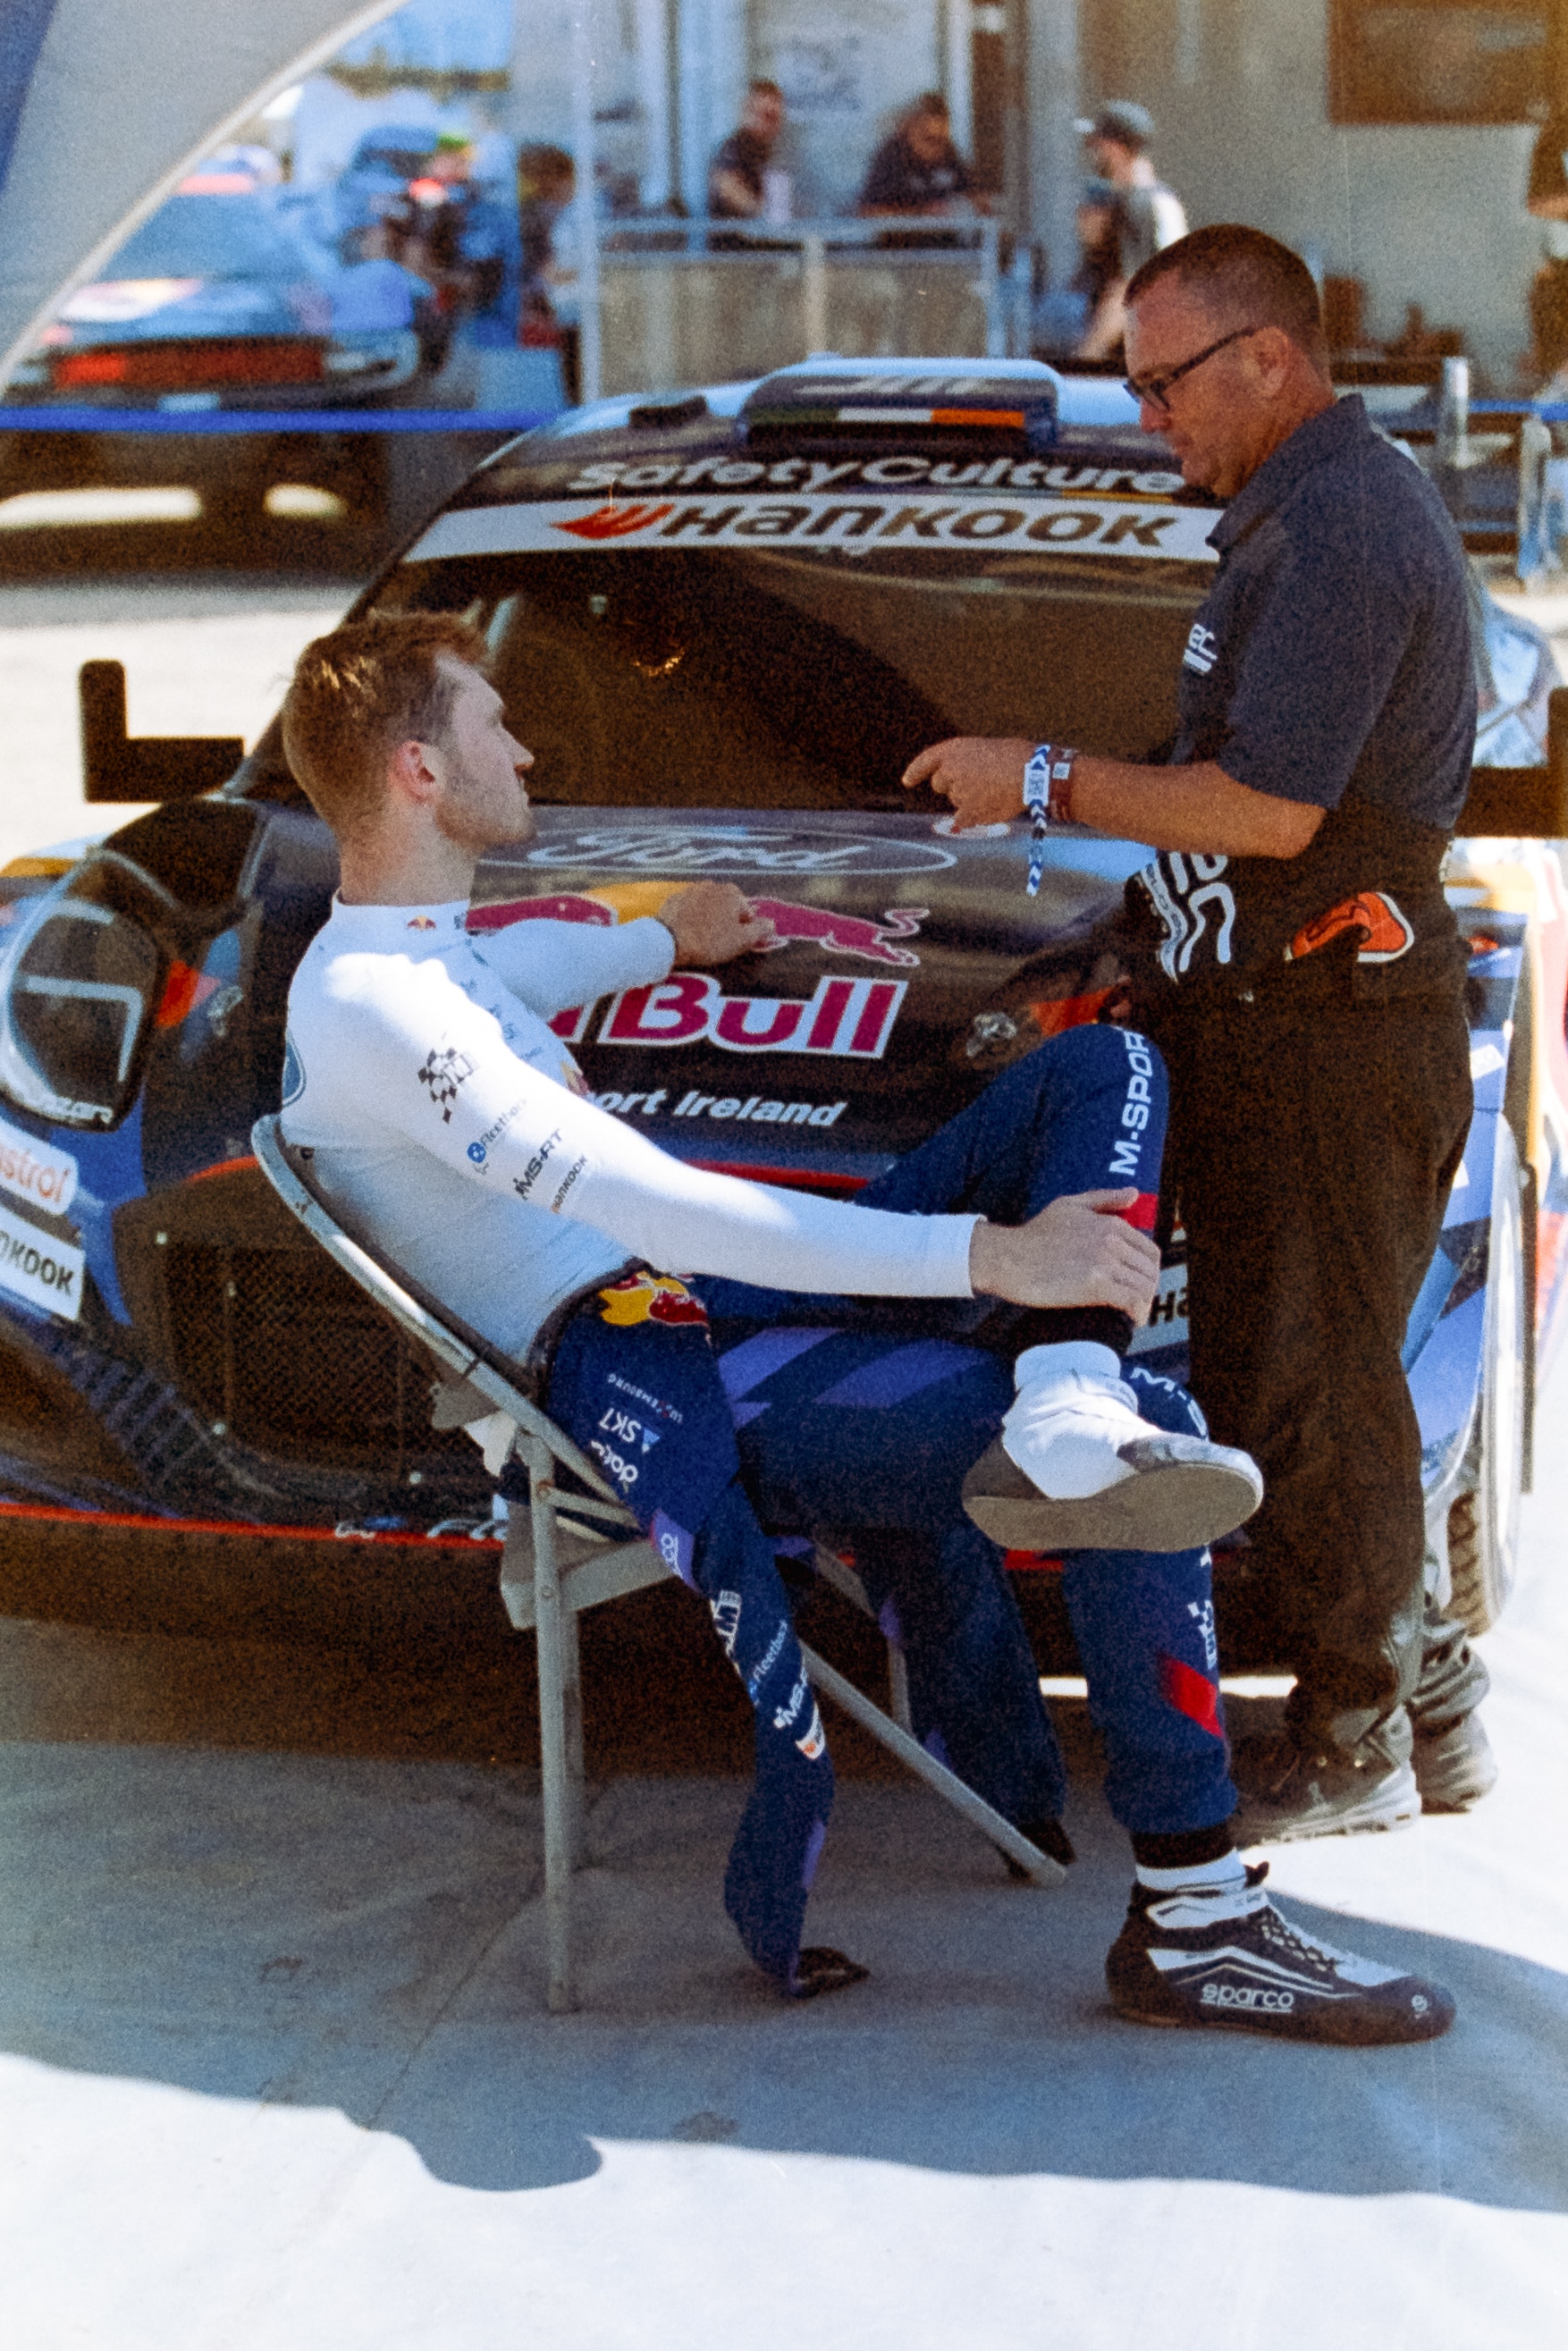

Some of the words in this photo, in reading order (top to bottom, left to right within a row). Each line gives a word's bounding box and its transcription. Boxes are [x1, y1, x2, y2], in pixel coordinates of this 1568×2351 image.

[569, 456, 1185, 494] SafetyCulture
[526, 829, 871, 870] Ford
[599, 973, 906, 1058] Bull
[673, 1090, 848, 1127] Ireland
[1109, 1027, 1154, 1176] M-SPOR
[1201, 1982, 1295, 2010] sparco
